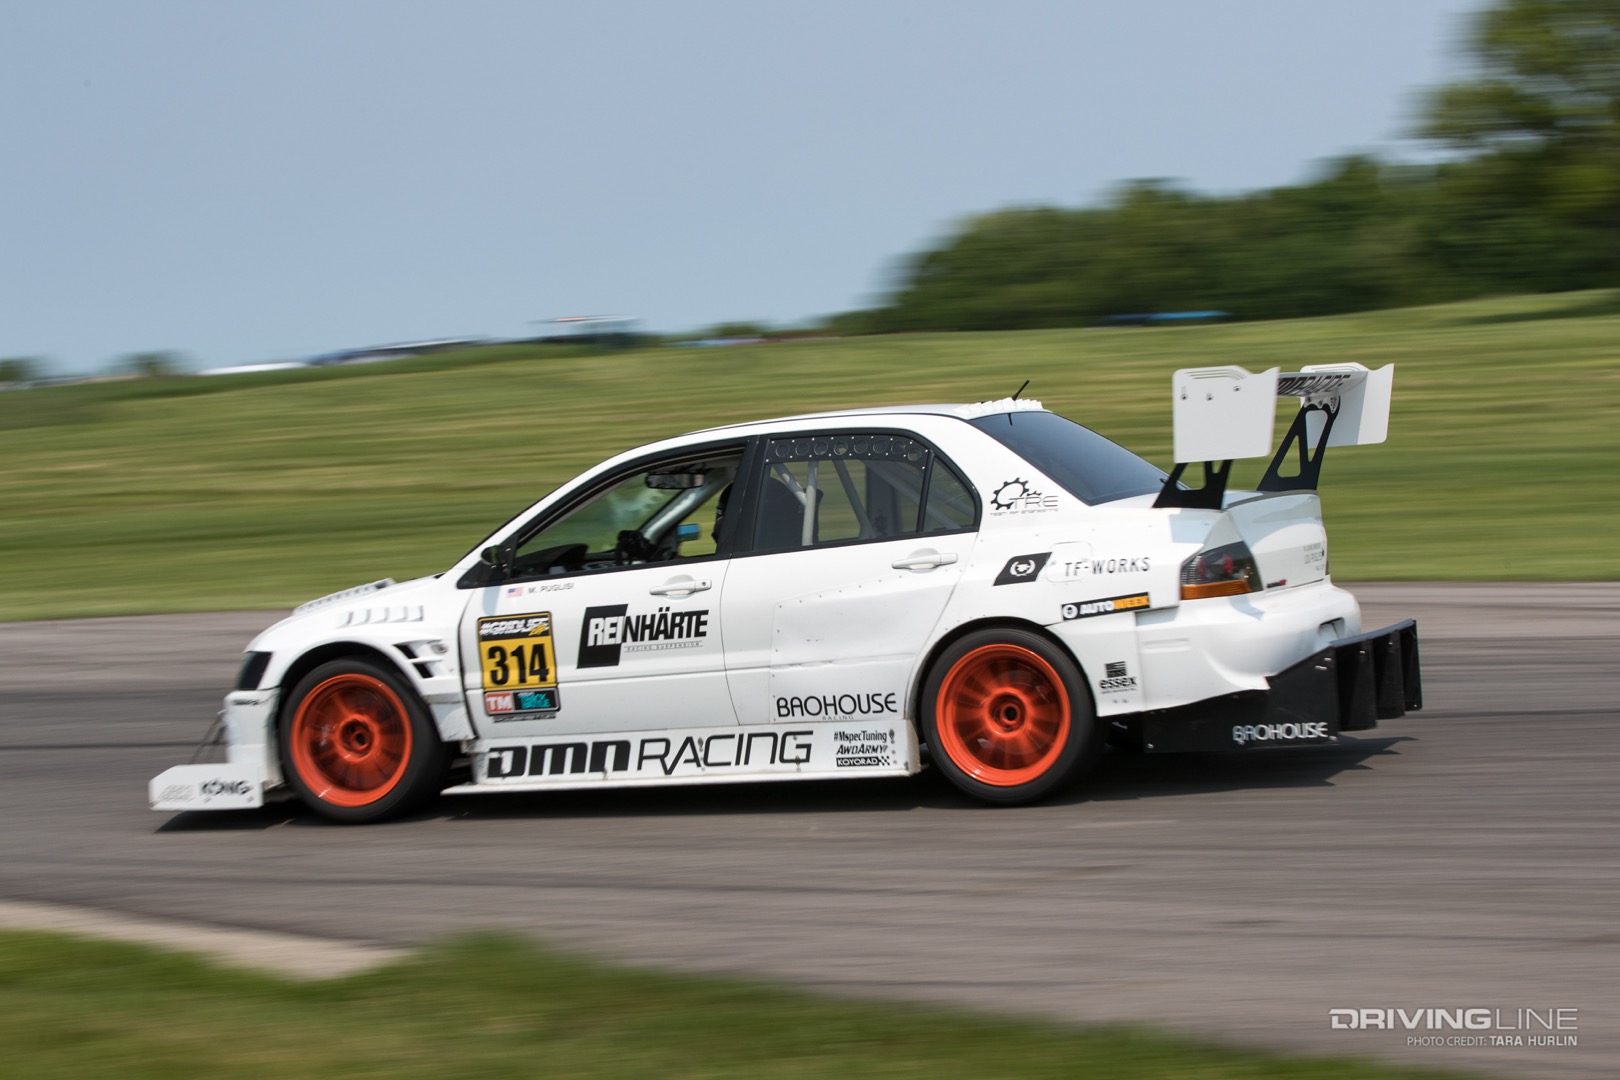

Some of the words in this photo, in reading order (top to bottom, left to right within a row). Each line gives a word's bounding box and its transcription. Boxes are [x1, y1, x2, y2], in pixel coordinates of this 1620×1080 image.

[1009, 496, 1058, 509] TRE
[1065, 557, 1150, 576] TF-WORKS
[587, 606, 709, 647] REINHÄRTE
[487, 643, 549, 686] 314
[1100, 677, 1137, 689] essex
[486, 694, 512, 711] TM
[776, 692, 898, 717] BAOHOUSE
[1232, 722, 1328, 741] BAOHOUSE
[837, 757, 879, 766] KOYORAD
